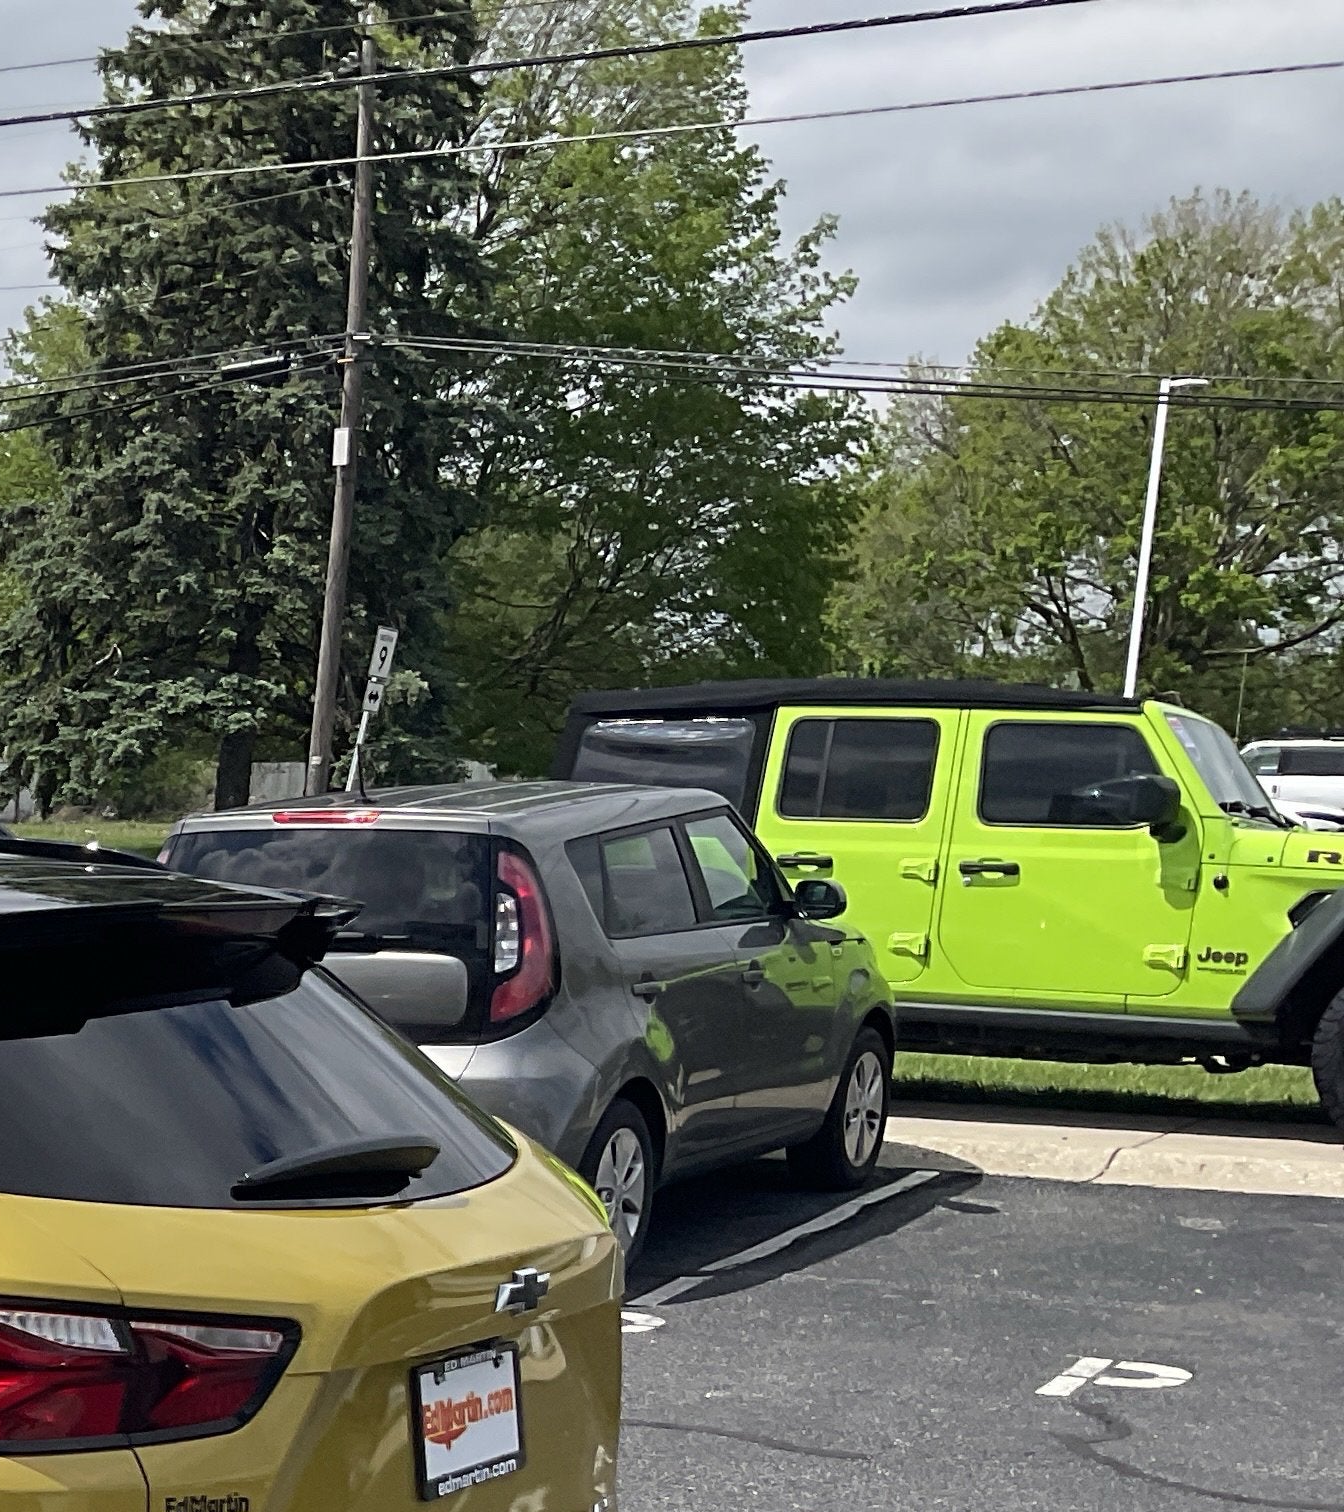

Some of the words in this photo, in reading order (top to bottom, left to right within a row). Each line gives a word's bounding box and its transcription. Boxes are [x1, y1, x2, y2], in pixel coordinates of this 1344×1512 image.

[378, 646, 388, 672] 9
[1197, 946, 1248, 967] Jeep
[444, 1359, 458, 1372] ED
[438, 1458, 518, 1496] edmartin.com
